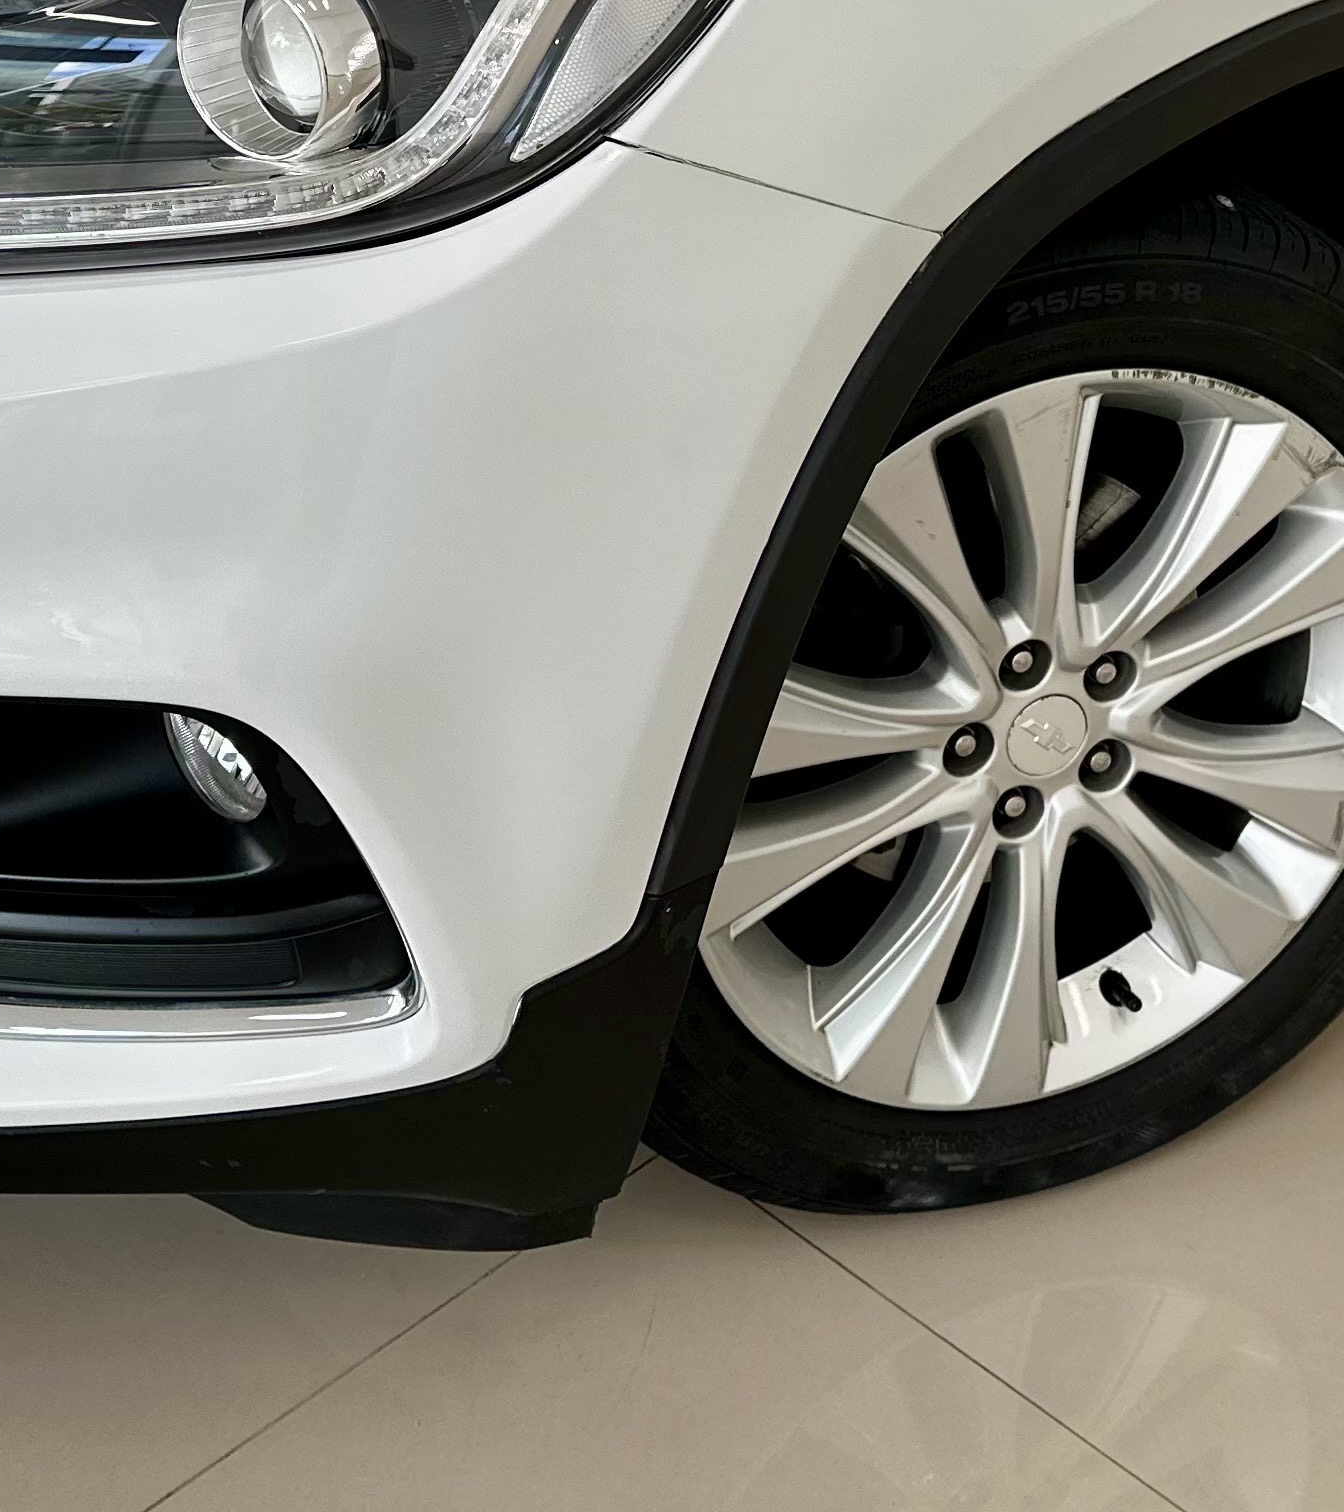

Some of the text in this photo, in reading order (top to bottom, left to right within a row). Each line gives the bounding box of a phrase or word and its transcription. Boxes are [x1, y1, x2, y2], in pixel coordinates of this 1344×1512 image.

[1006, 279, 1203, 327] 215/55 R 18
